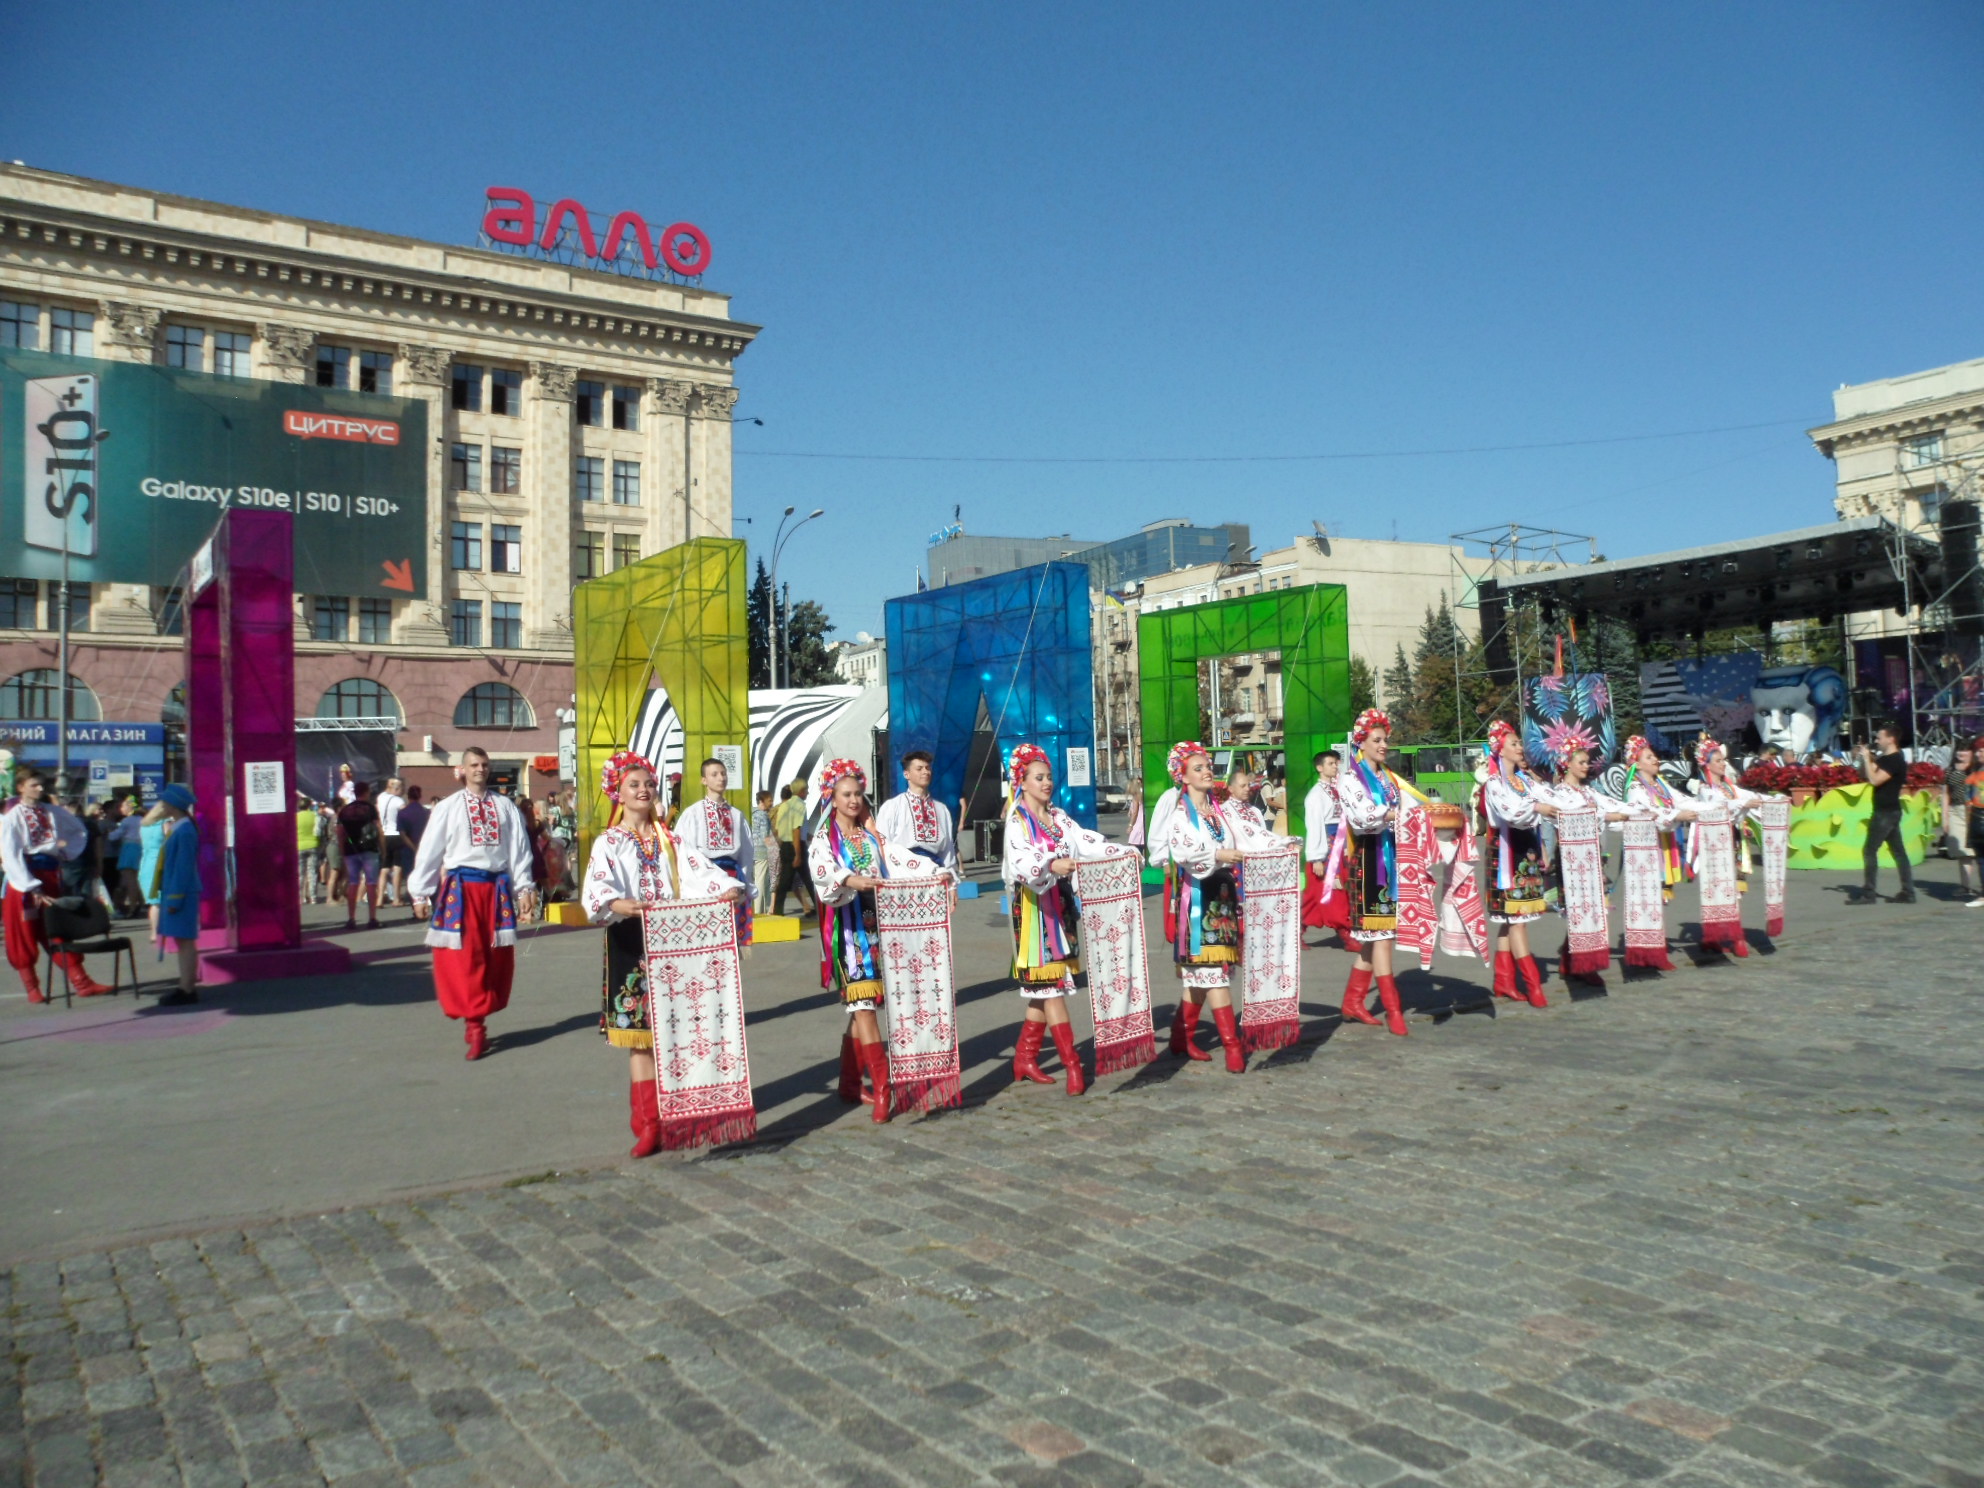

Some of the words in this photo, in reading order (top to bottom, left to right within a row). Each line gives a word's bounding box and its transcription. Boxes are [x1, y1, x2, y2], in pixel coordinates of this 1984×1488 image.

[289, 415, 396, 441] ЦИТРУС
[46, 386, 96, 526] S10+
[140, 477, 233, 509] Galaxy
[238, 486, 292, 508] S10e
[306, 492, 341, 512] S10
[356, 496, 400, 516] S10+
[65, 728, 147, 741] МАГАЗИН
